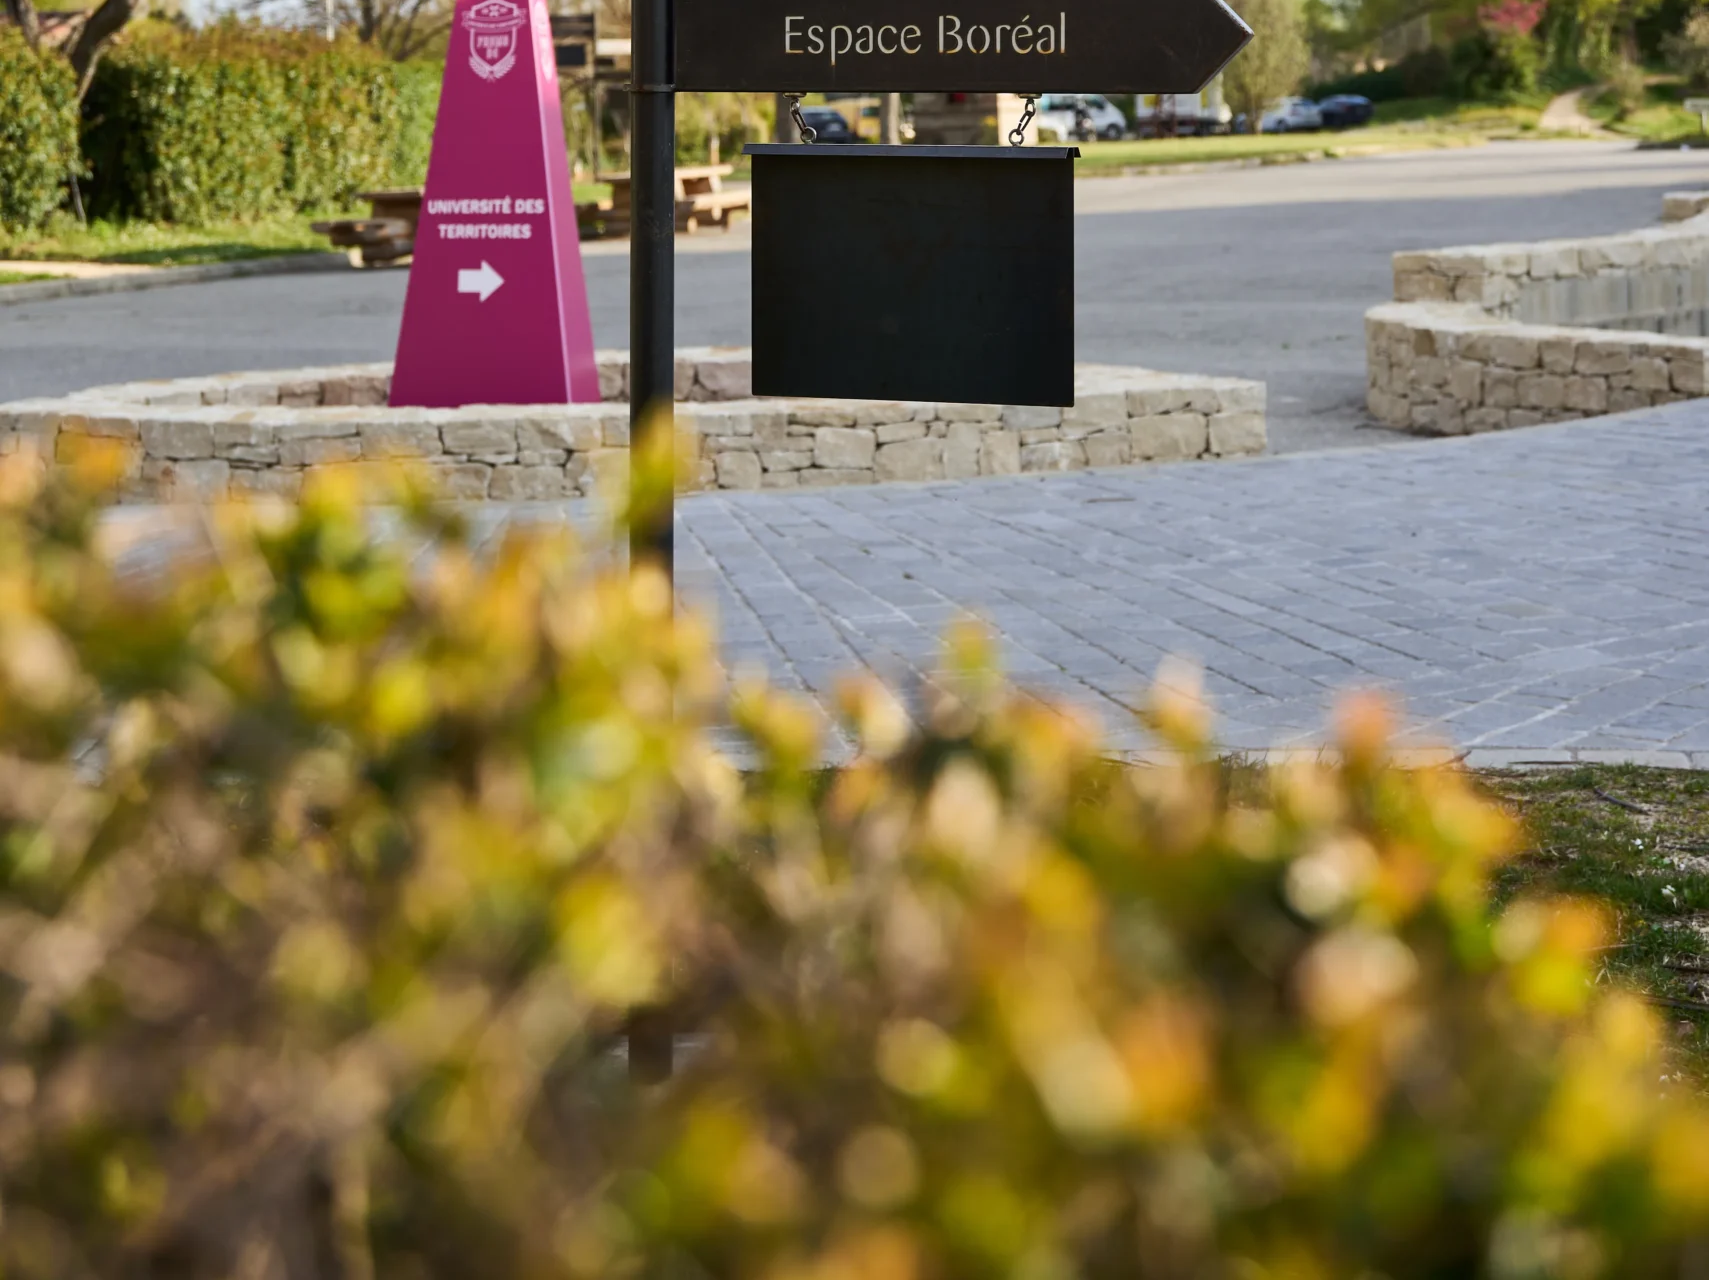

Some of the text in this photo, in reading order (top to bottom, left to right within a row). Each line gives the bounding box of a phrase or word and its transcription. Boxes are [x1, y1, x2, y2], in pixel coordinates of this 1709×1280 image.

[784, 11, 1067, 66] Espace Boréal
[427, 195, 545, 214] UNIVERSITÉ DES
[438, 223, 532, 239] TERRITOIRES
